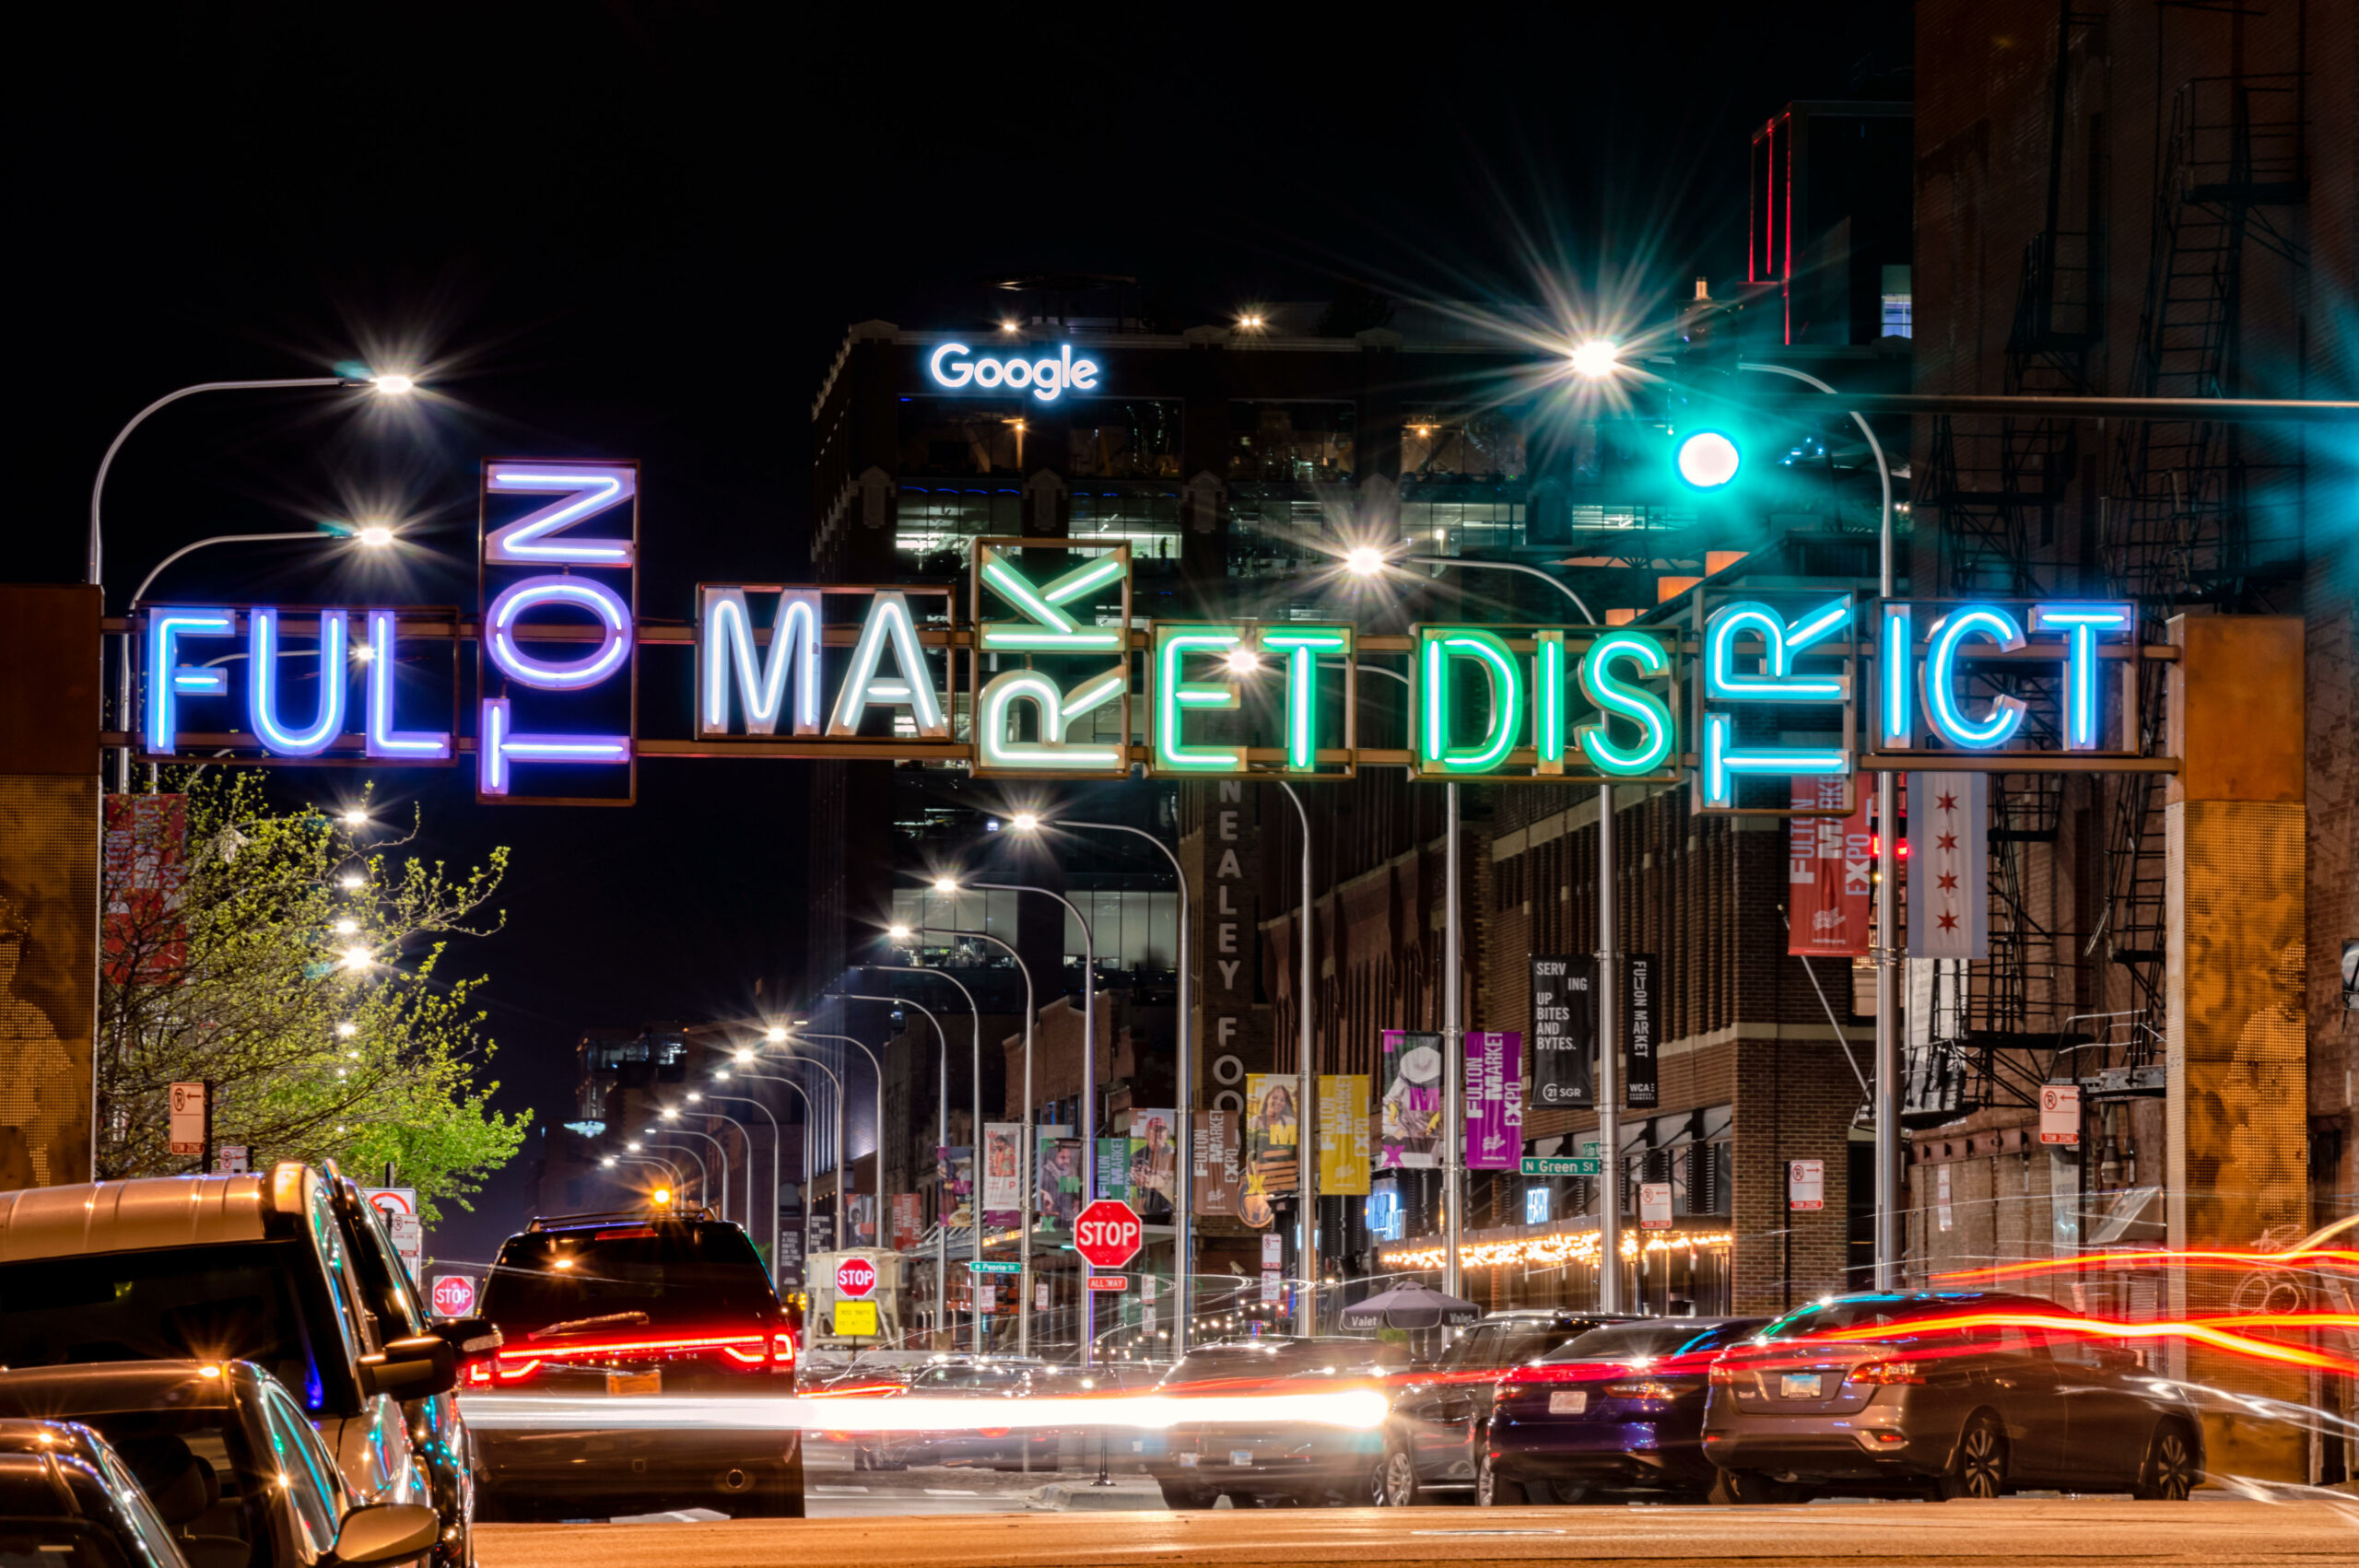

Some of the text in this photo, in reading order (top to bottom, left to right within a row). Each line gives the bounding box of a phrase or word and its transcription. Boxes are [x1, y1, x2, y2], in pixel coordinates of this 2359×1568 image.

[931, 344, 1098, 400] Google
[1536, 962, 1566, 976] SERV
[1567, 977, 1588, 991] ING
[1536, 992, 1553, 1005] UP
[1536, 1007, 1570, 1020] BITES
[1633, 961, 1649, 1058] FULTON MARKET
[1536, 1022, 1560, 1036] AND
[1536, 1036, 1577, 1050] BYTES.
[1485, 1032, 1504, 1101] MARKET
[1465, 1057, 1484, 1118] FULTON
[1559, 1088, 1581, 1097] SGR
[1336, 1075, 1353, 1134] MARKET
[1320, 1097, 1335, 1151] FULTON
[1209, 1109, 1224, 1163] MARKET
[1193, 1129, 1209, 1176] FULTON
[1111, 1138, 1124, 1185] MARKET
[1526, 1160, 1594, 1173] N Green St
[1097, 1155, 1110, 1198] FULTON
[1079, 1222, 1137, 1246] STOP
[982, 1263, 1006, 1271] Peoria
[839, 1270, 874, 1286] STOP
[1090, 1279, 1123, 1288] ALL WAY
[435, 1287, 472, 1305] STOP
[1351, 1316, 1378, 1327] Valet
